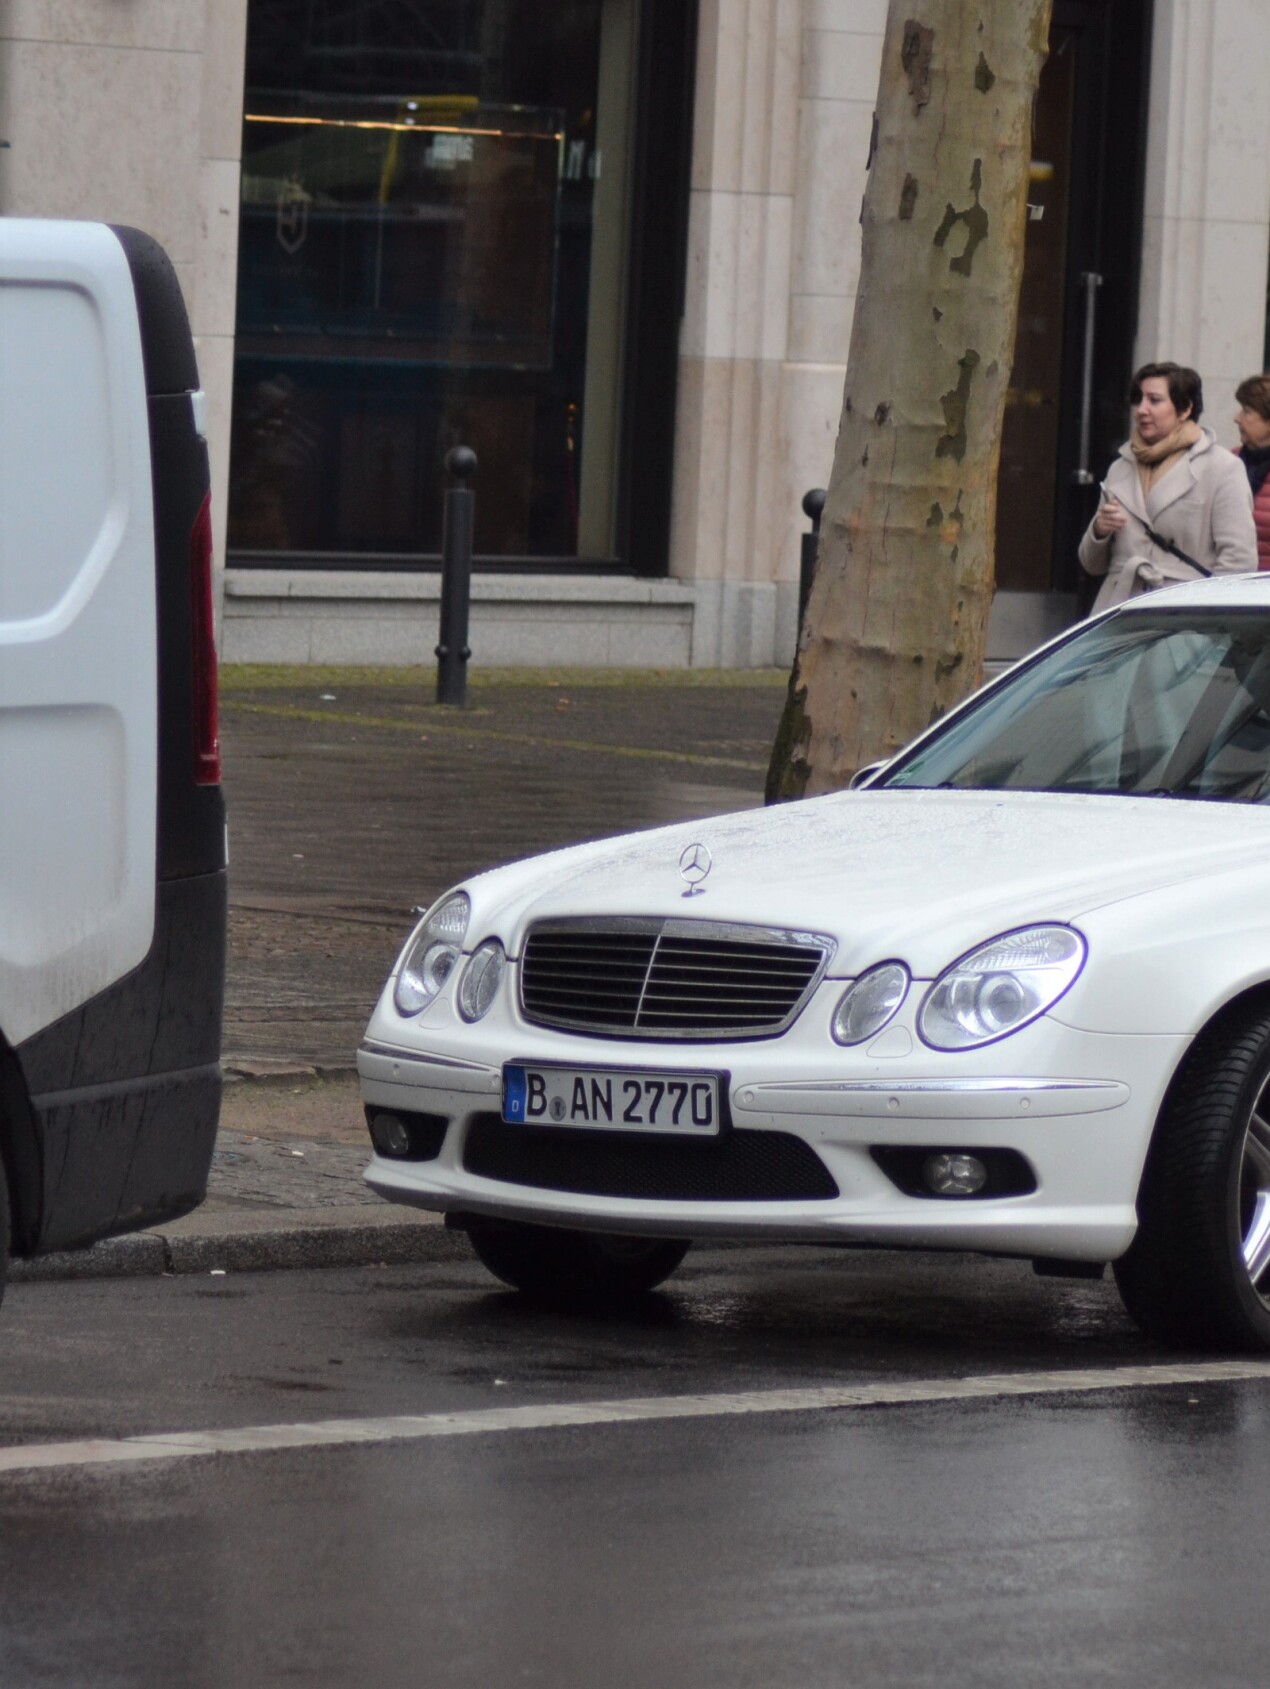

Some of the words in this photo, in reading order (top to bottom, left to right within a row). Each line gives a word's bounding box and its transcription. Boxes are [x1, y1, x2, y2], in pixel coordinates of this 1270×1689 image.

[511, 1100, 519, 1112] D
[527, 1073, 547, 1117] B
[571, 1077, 613, 1121] AN
[623, 1080, 713, 1126] 2770
